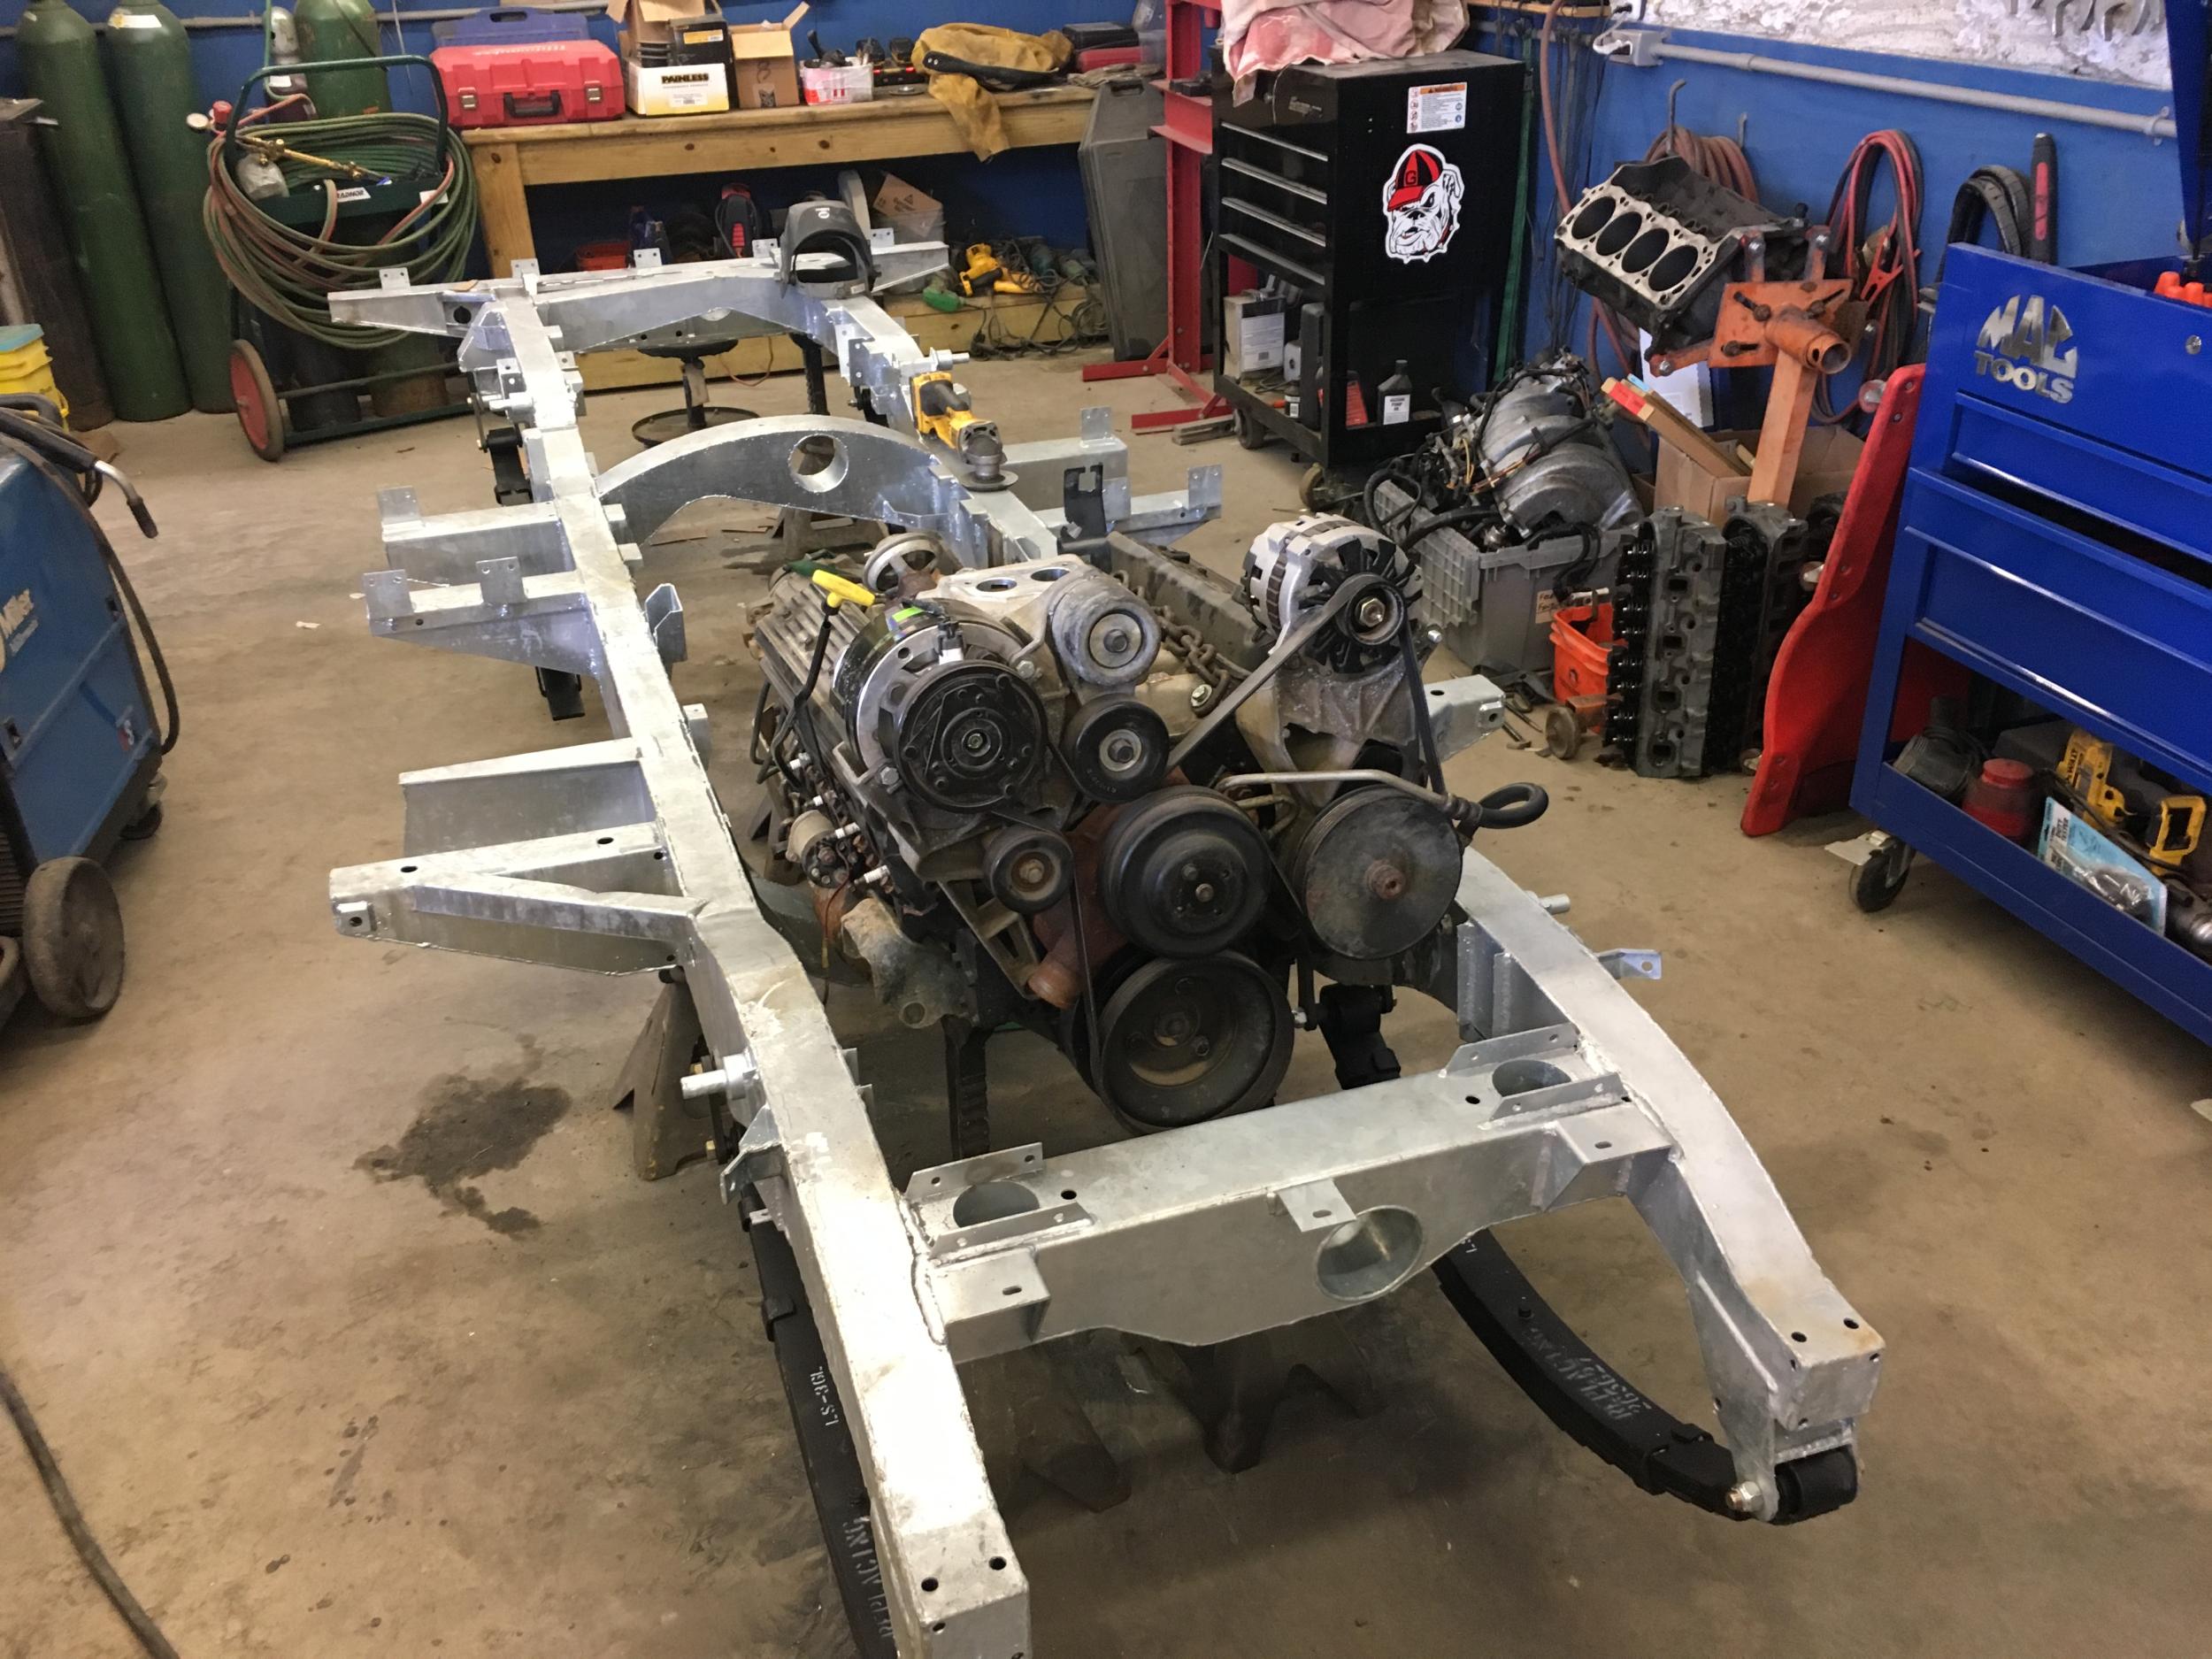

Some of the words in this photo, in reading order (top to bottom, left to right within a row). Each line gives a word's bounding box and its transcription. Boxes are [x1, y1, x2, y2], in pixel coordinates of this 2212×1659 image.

[661, 73, 710, 84] PAINLESS
[1405, 170, 1417, 185] G
[1976, 294, 2078, 379] MAC
[1974, 349, 2074, 403] TOOLS
